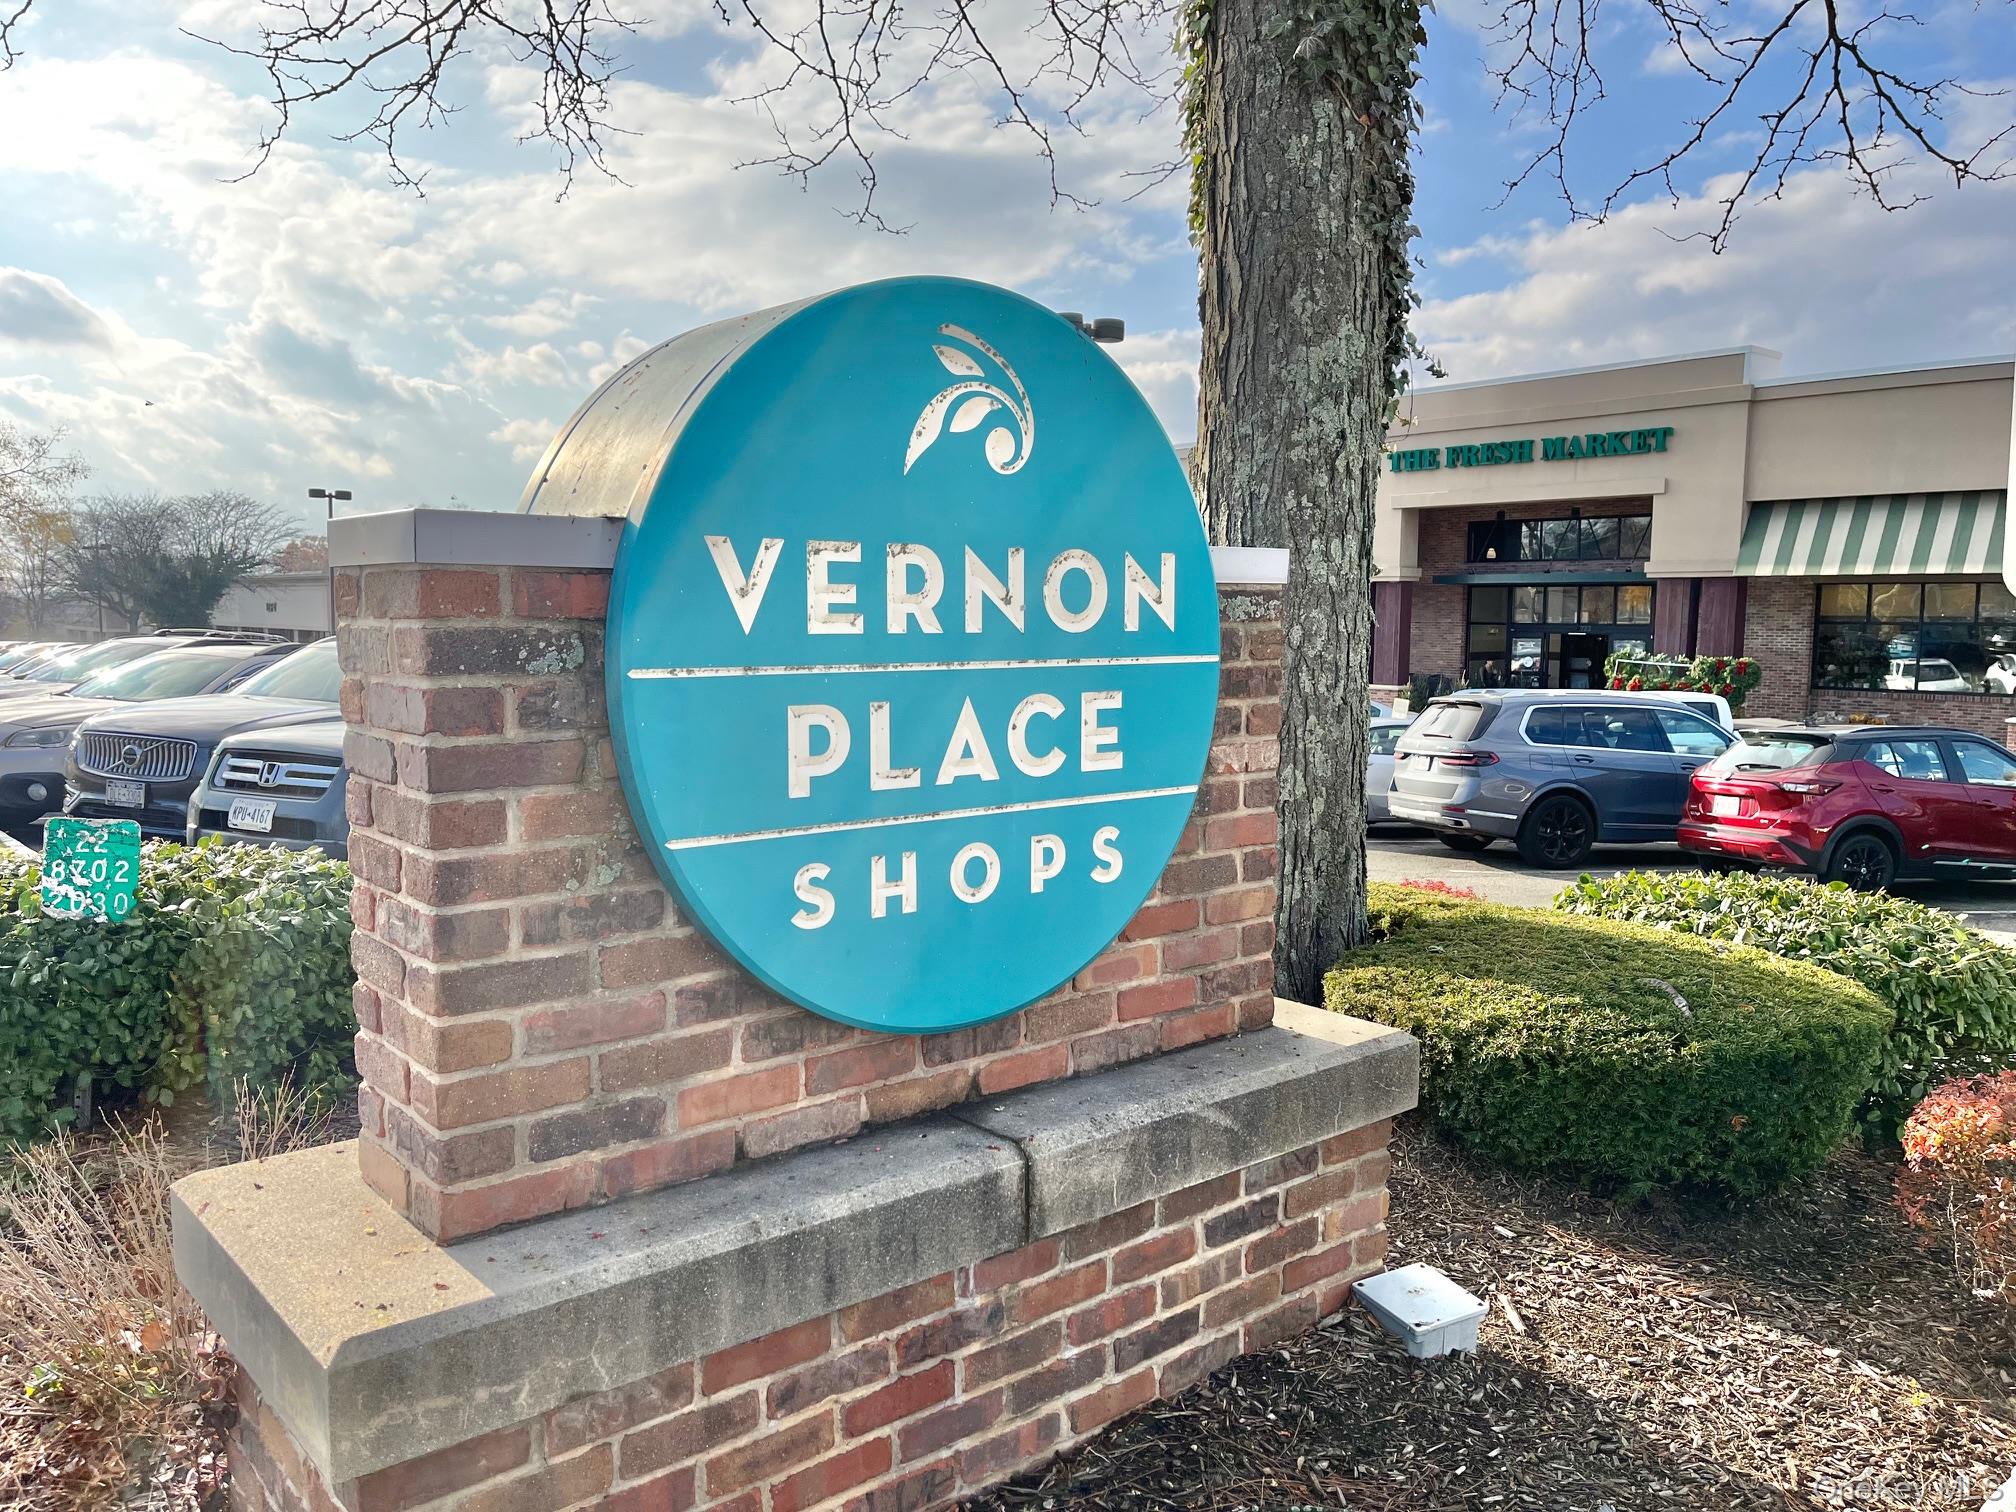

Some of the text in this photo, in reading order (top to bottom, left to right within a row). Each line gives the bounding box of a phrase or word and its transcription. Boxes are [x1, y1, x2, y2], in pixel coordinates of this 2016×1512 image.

[1388, 427, 1674, 472] THE FRESH MARKET
[704, 535, 1175, 635] VERNON
[788, 691, 1123, 799] PLACE
[76, 830, 108, 853] 22
[790, 826, 1123, 930] SHOPS
